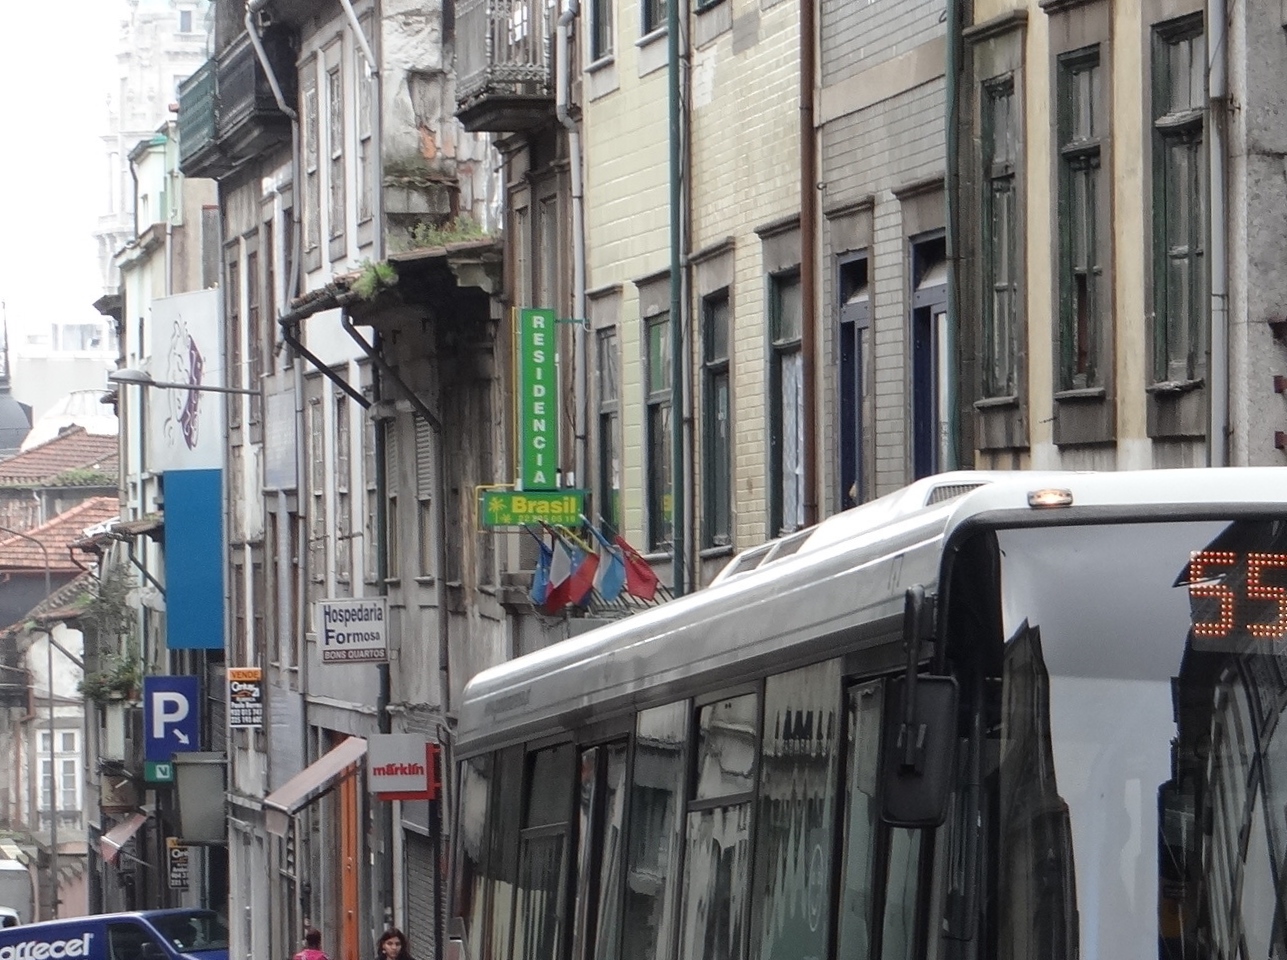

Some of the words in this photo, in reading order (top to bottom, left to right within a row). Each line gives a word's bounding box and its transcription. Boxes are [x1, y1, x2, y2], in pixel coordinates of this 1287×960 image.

[532, 315, 546, 484] RESIDENCIA
[511, 496, 576, 513] Brasil
[324, 603, 383, 627] Hospedaria
[325, 628, 380, 645] Formosa
[325, 651, 346, 659] BONS
[348, 649, 385, 658] QUARTOS
[231, 671, 259, 679] VENDE
[153, 692, 190, 738] P
[373, 763, 424, 776] märklin
